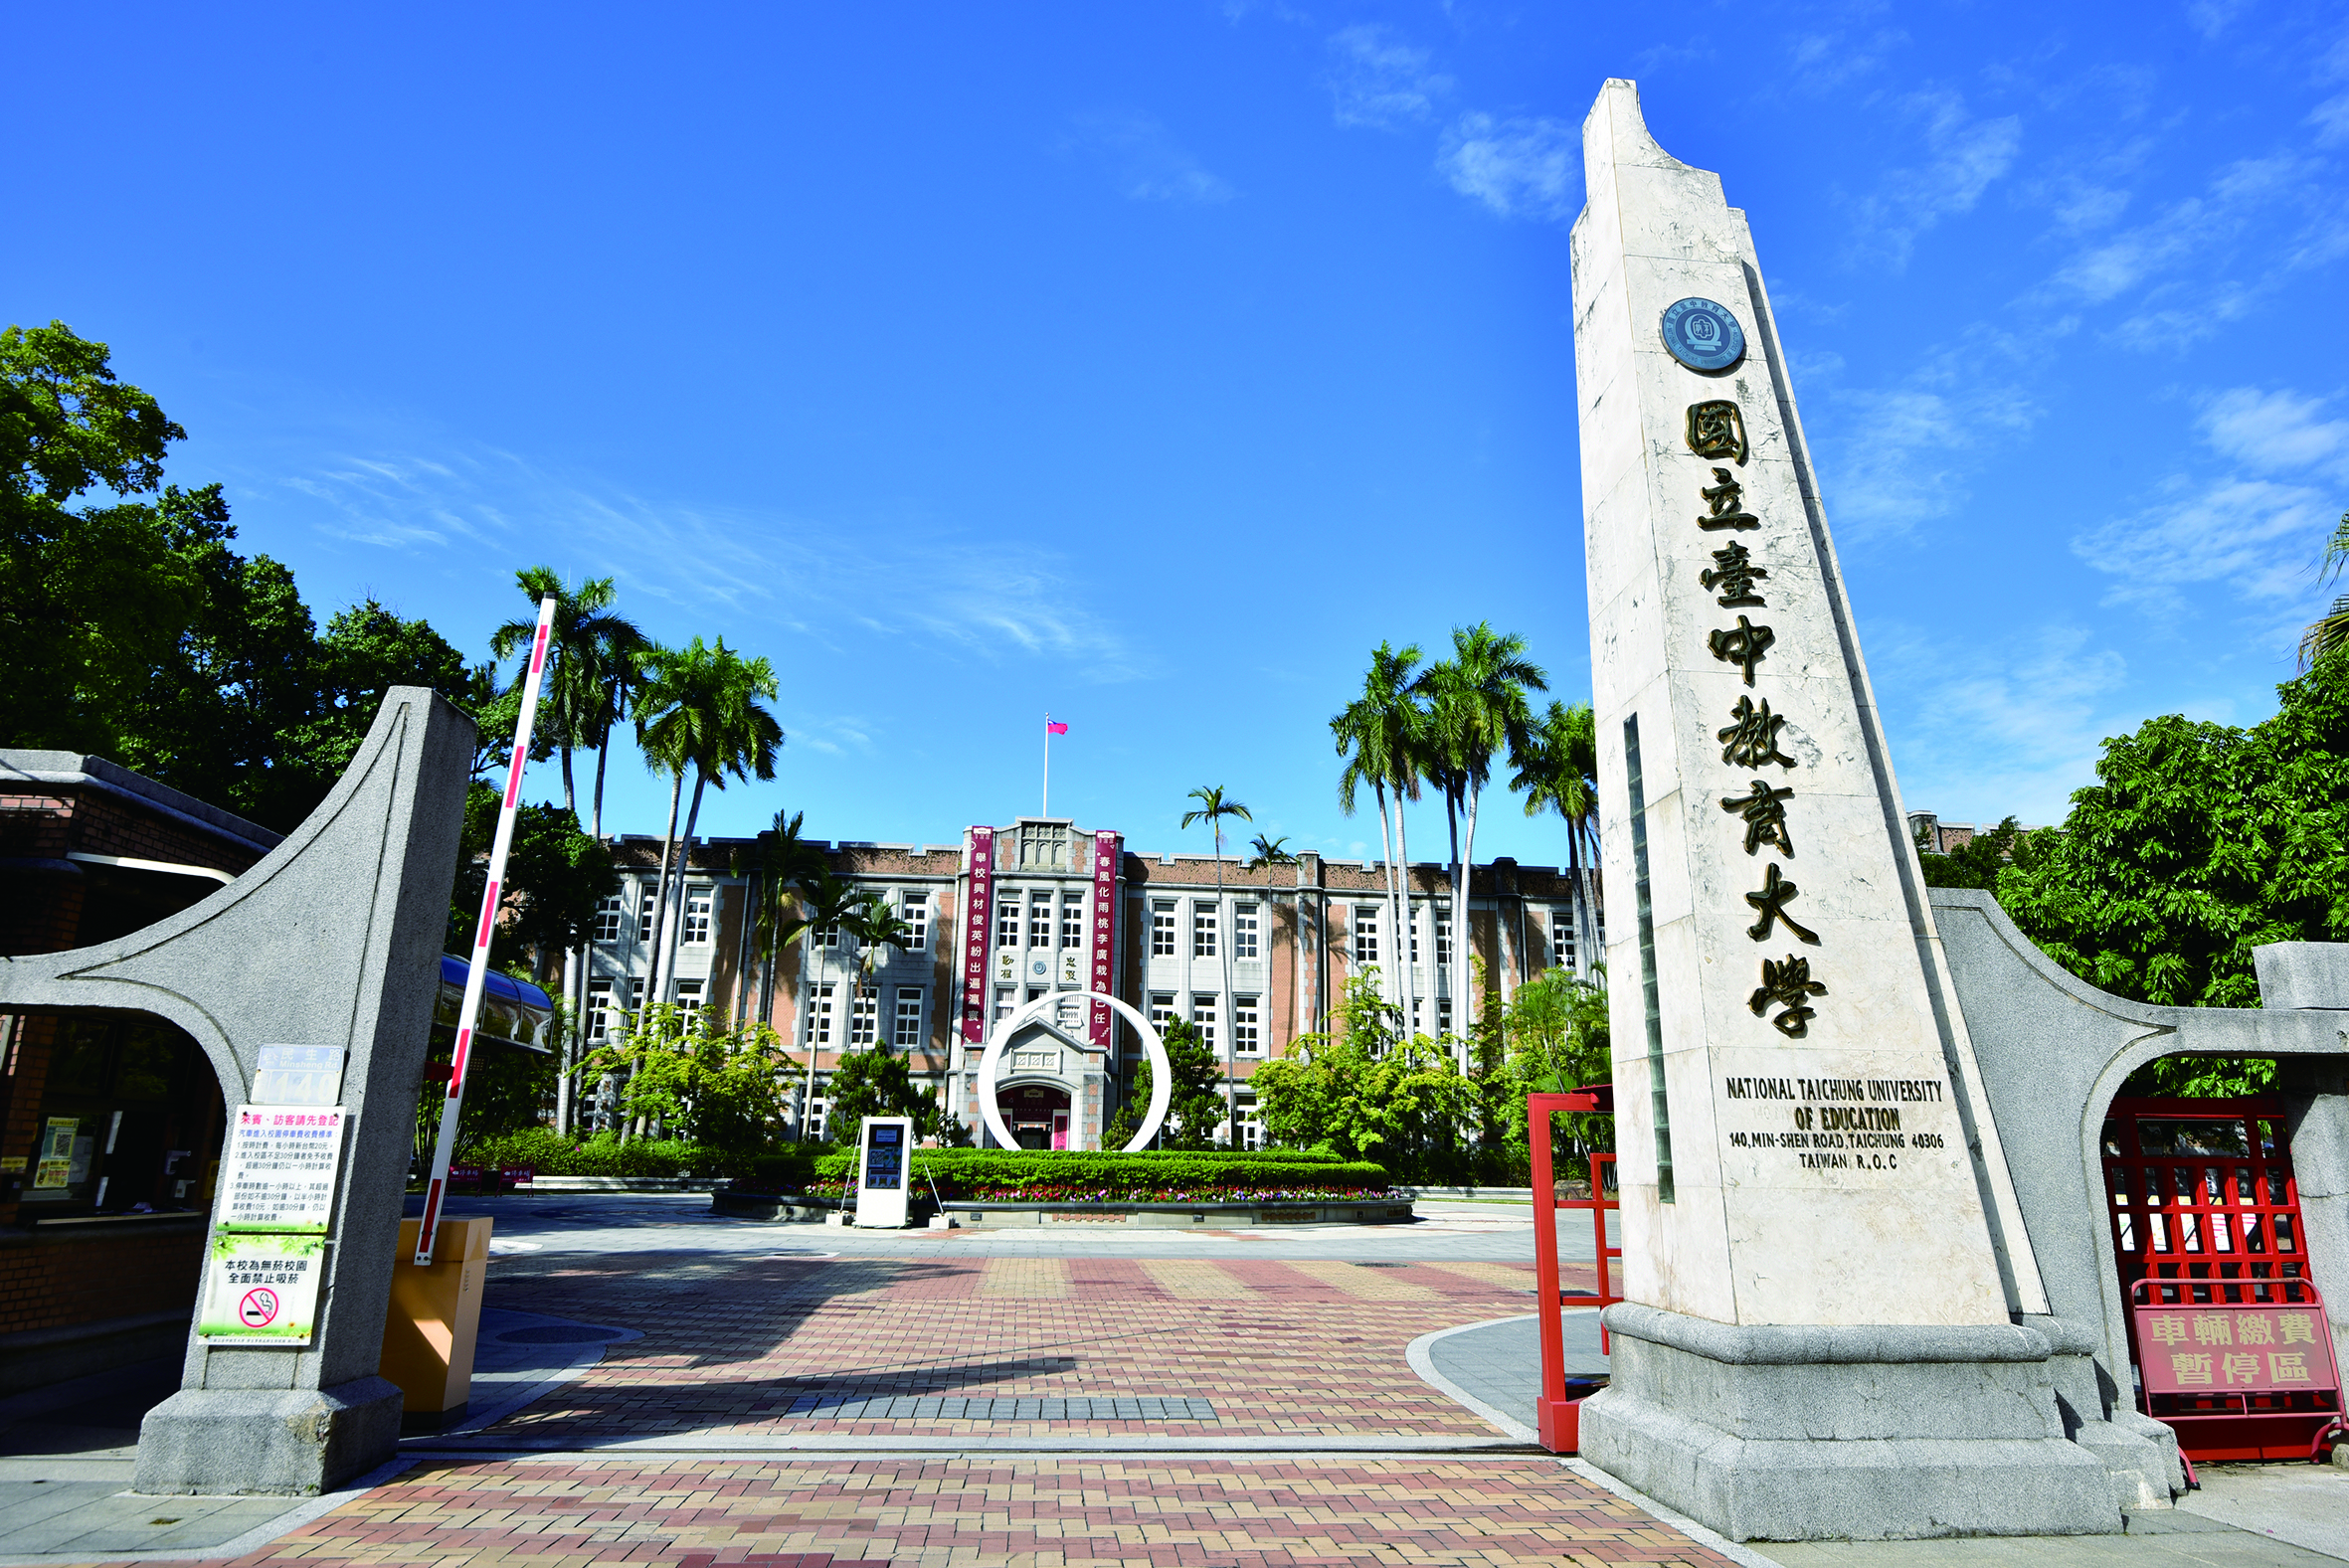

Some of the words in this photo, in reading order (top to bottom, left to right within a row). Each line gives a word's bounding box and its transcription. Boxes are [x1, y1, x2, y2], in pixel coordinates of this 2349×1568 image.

[1685, 399, 1828, 1040] 國立臺中教育大學
[281, 1047, 341, 1061] 民生路
[279, 1060, 323, 1070] Minsheng
[324, 1061, 340, 1070] Rd.
[275, 1072, 335, 1103] 140
[1726, 1077, 1795, 1100] NATIONAL
[1797, 1078, 1864, 1101] TAICHUNG
[1867, 1079, 1942, 1102] UNIVERSITY
[240, 1114, 339, 1127] 來賓、訪客請先登記
[1794, 1107, 1813, 1131] OF
[1820, 1107, 1900, 1131] EDUCATION
[1911, 1133, 1944, 1148] 40306
[1799, 1152, 1848, 1169] TAIWAN
[225, 1259, 307, 1272] 本校為無菸校園
[228, 1272, 299, 1285] 全面禁止吸菸
[2148, 1313, 2317, 1346] 車輛繳費
[2170, 1351, 2311, 1385] 暫停區
